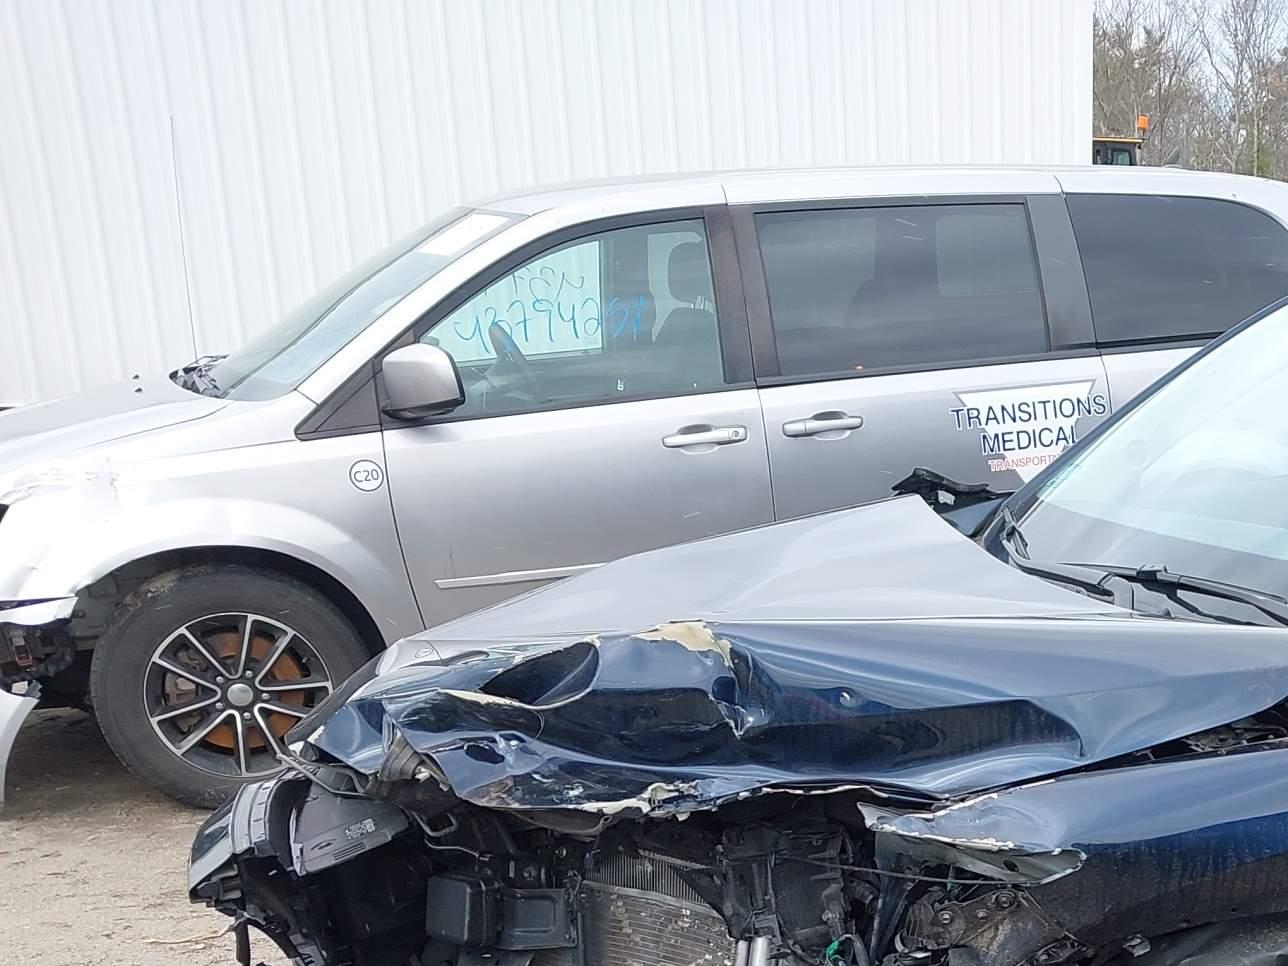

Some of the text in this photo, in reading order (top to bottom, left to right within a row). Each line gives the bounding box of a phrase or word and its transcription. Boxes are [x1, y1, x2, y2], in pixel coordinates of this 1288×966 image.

[951, 394, 1107, 430] TRANSITIONS
[982, 424, 1077, 454] MEDICAL
[353, 468, 380, 483] C20
